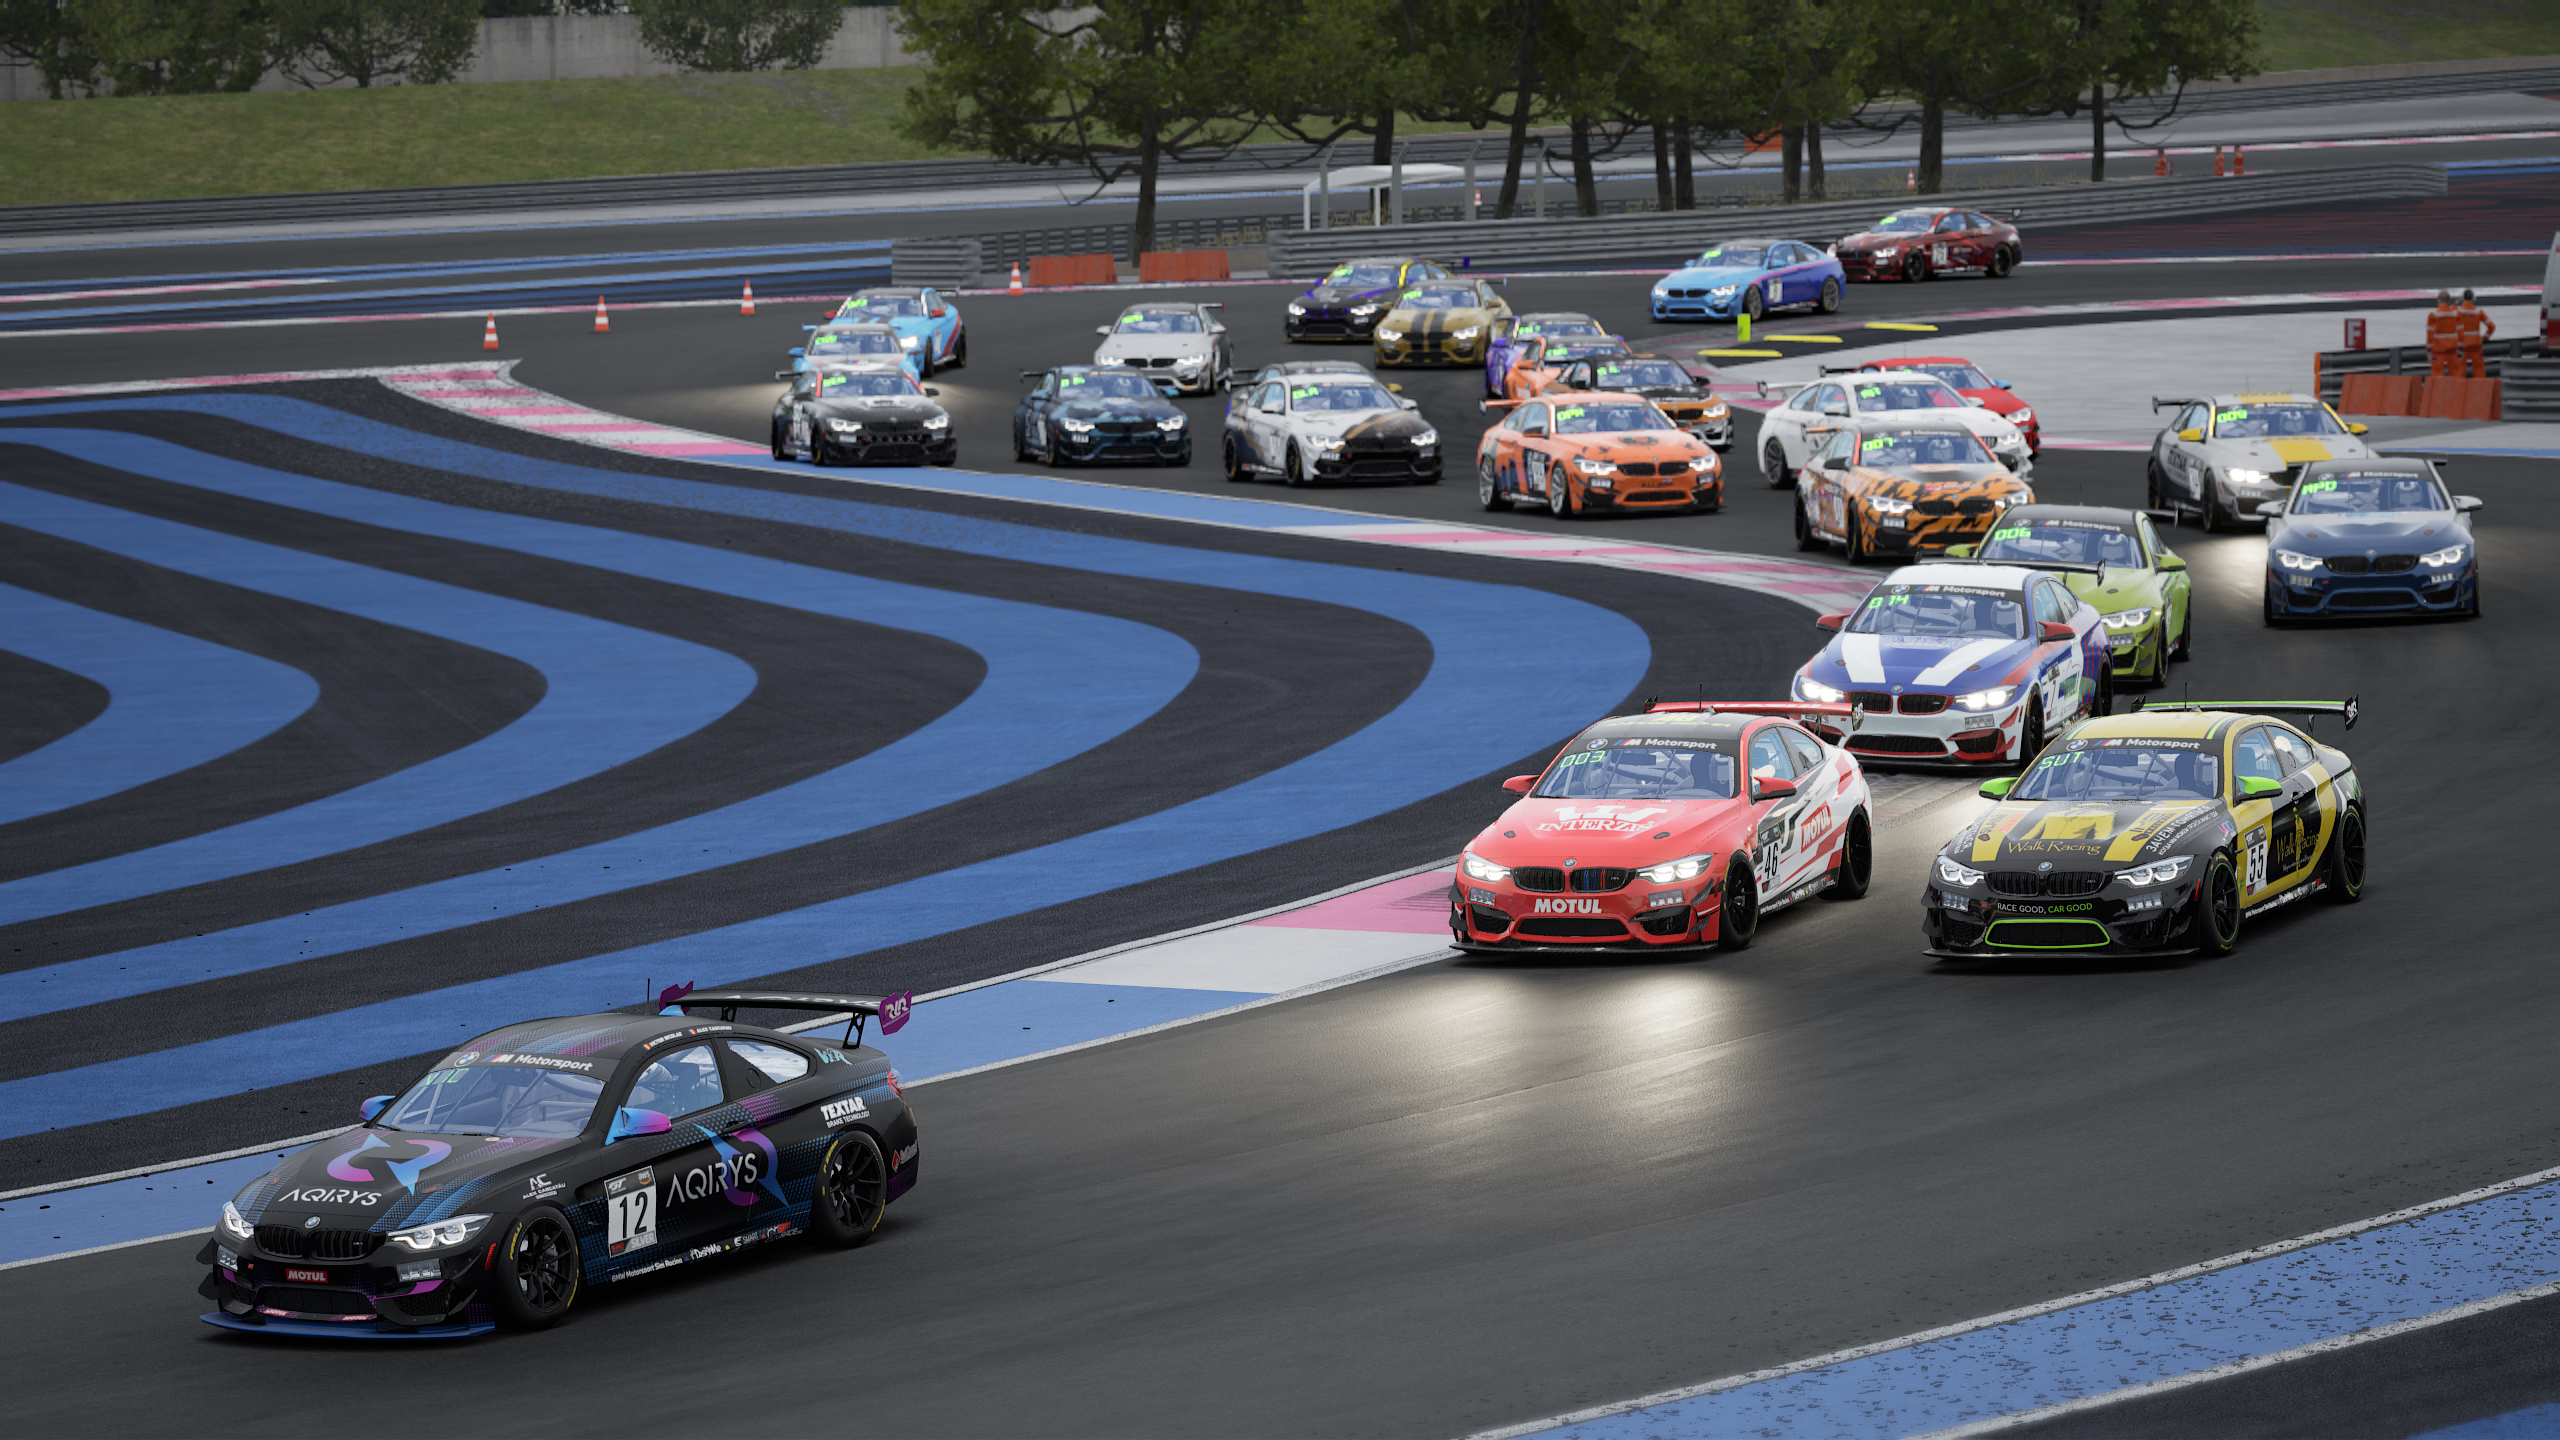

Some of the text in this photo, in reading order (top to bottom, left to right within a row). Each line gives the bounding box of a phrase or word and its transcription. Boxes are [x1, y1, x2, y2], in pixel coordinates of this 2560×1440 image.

[2347, 321, 2361, 346] F
[2364, 471, 2418, 479] Motorsport
[1995, 527, 2031, 541] 006
[2062, 520, 2121, 532] Motorsport
[1942, 585, 2005, 598] Motorsport
[1645, 738, 1717, 750] Motorsport
[2126, 738, 2200, 750] Motorsport
[1560, 750, 1606, 768] 003
[2038, 751, 2085, 770] SUT
[1803, 805, 1831, 848] MOTUL
[2007, 840, 2102, 855] Walk Racing
[2146, 826, 2177, 853] ЗАЧЕМ
[2277, 832, 2295, 865] Walk
[1764, 842, 1779, 880] 46
[2249, 843, 2264, 883] 55
[1534, 898, 1602, 914] MOTUL
[1997, 902, 2017, 912] RACE
[2047, 904, 2065, 914] CAR
[2066, 902, 2093, 913] GOOD
[514, 1054, 593, 1071] Motorsport
[426, 1068, 470, 1086] VIC
[820, 1097, 867, 1120] TEXTAR
[827, 1110, 870, 1128] BRAKE TECHNOLOGY
[666, 1153, 758, 1208] AQIRYS
[278, 1188, 382, 1206] AQIRYS
[522, 1189, 537, 1200] ALEX
[619, 1191, 648, 1239] 12
[630, 1233, 656, 1249] SILVER
[288, 1270, 326, 1281] MOTUL
[612, 1271, 626, 1282] BMW
[626, 1265, 655, 1279] Motorsport
[665, 1257, 683, 1268] Racing
